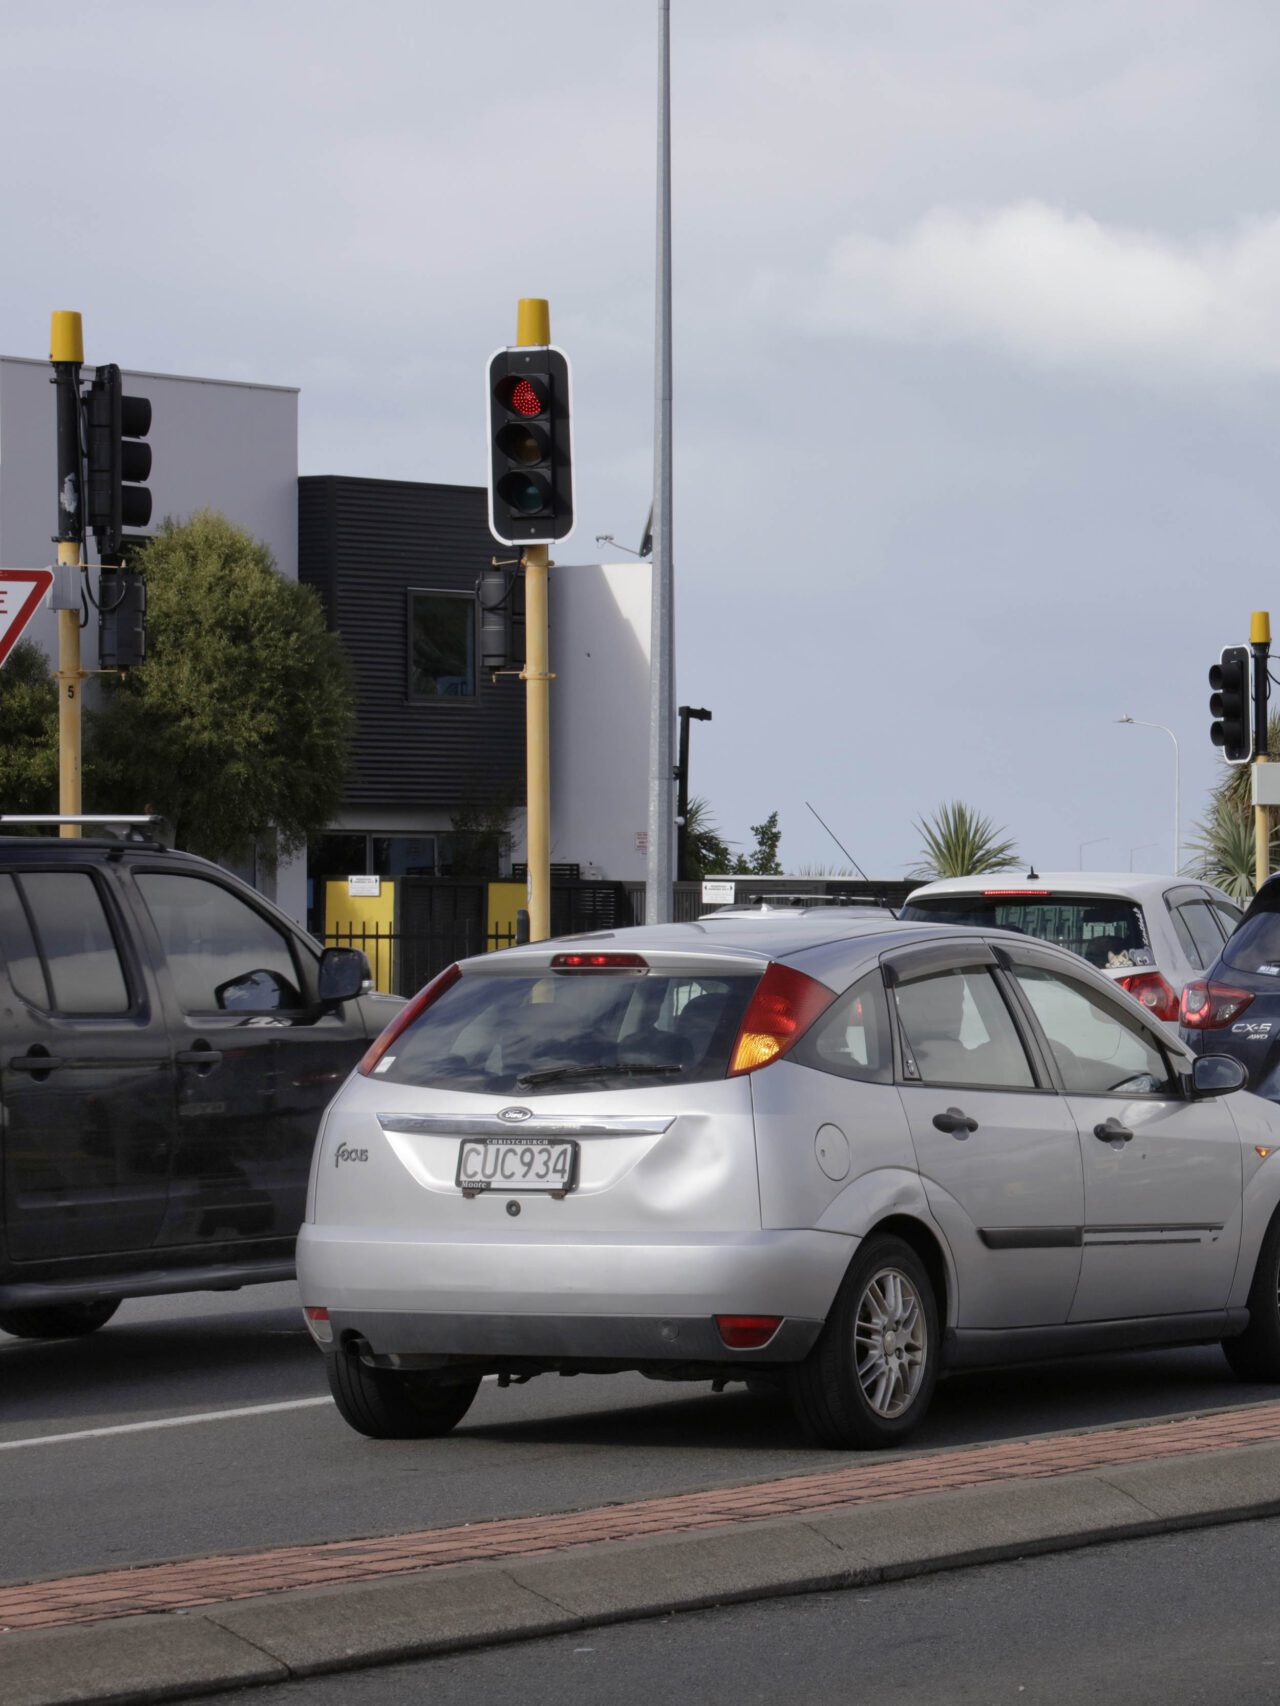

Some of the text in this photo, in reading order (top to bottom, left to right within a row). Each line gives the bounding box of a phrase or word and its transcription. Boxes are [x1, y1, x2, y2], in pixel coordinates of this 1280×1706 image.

[67, 685, 75, 699] 5
[1231, 1023, 1273, 1034] CX-5
[504, 1110, 524, 1119] Ford
[462, 1147, 569, 1180] CUC934
[461, 1180, 488, 1189] Moore
